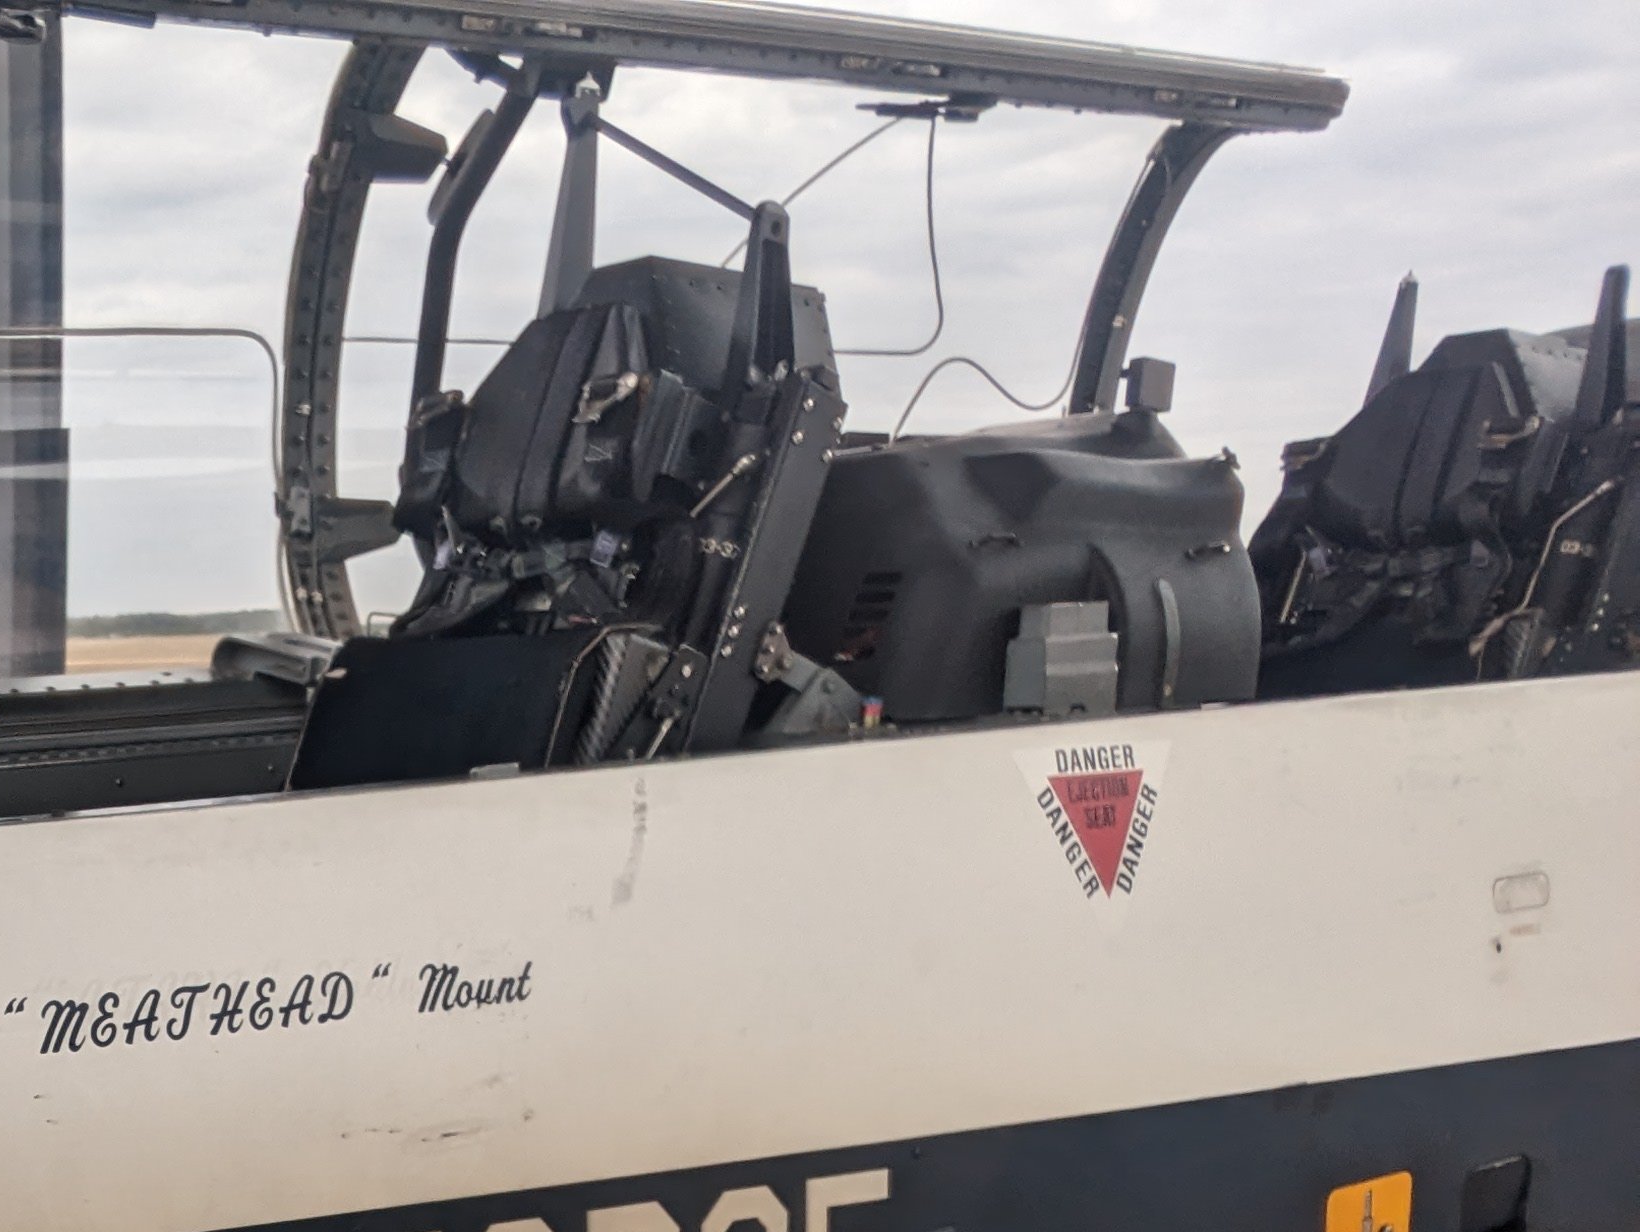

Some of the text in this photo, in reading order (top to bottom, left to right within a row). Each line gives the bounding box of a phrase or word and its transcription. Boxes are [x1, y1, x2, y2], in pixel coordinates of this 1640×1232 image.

[1055, 744, 1135, 773] DANGER
[1037, 786, 1100, 899] DANGER
[1117, 783, 1158, 894] DANGER
[418, 961, 532, 1013] Mount
